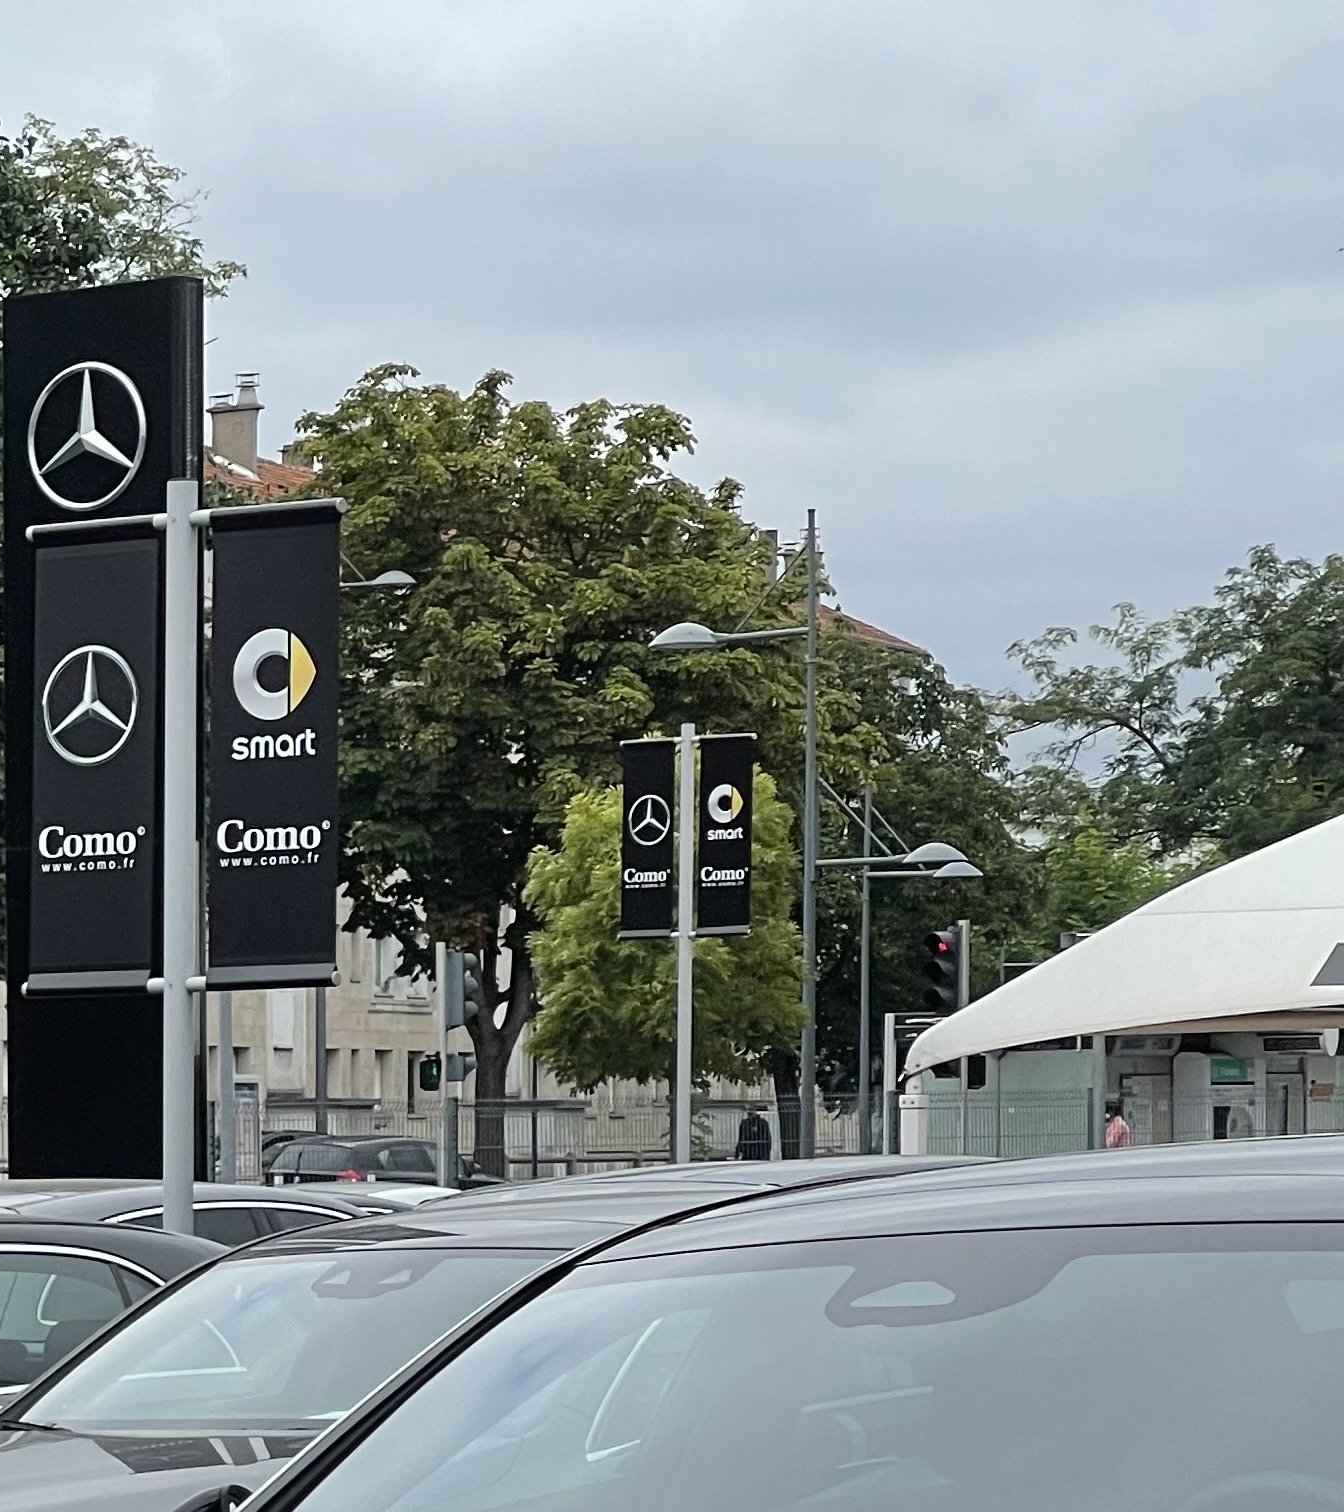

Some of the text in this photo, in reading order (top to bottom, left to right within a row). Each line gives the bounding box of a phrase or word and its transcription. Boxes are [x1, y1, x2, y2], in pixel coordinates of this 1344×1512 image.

[231, 728, 316, 761] smart
[38, 825, 137, 859] Como
[216, 819, 322, 853] Como
[707, 827, 744, 841] smart
[41, 857, 136, 873] www.como.fr
[219, 852, 320, 868] www.como.fr
[623, 868, 667, 883] Como
[700, 866, 745, 882] Como
